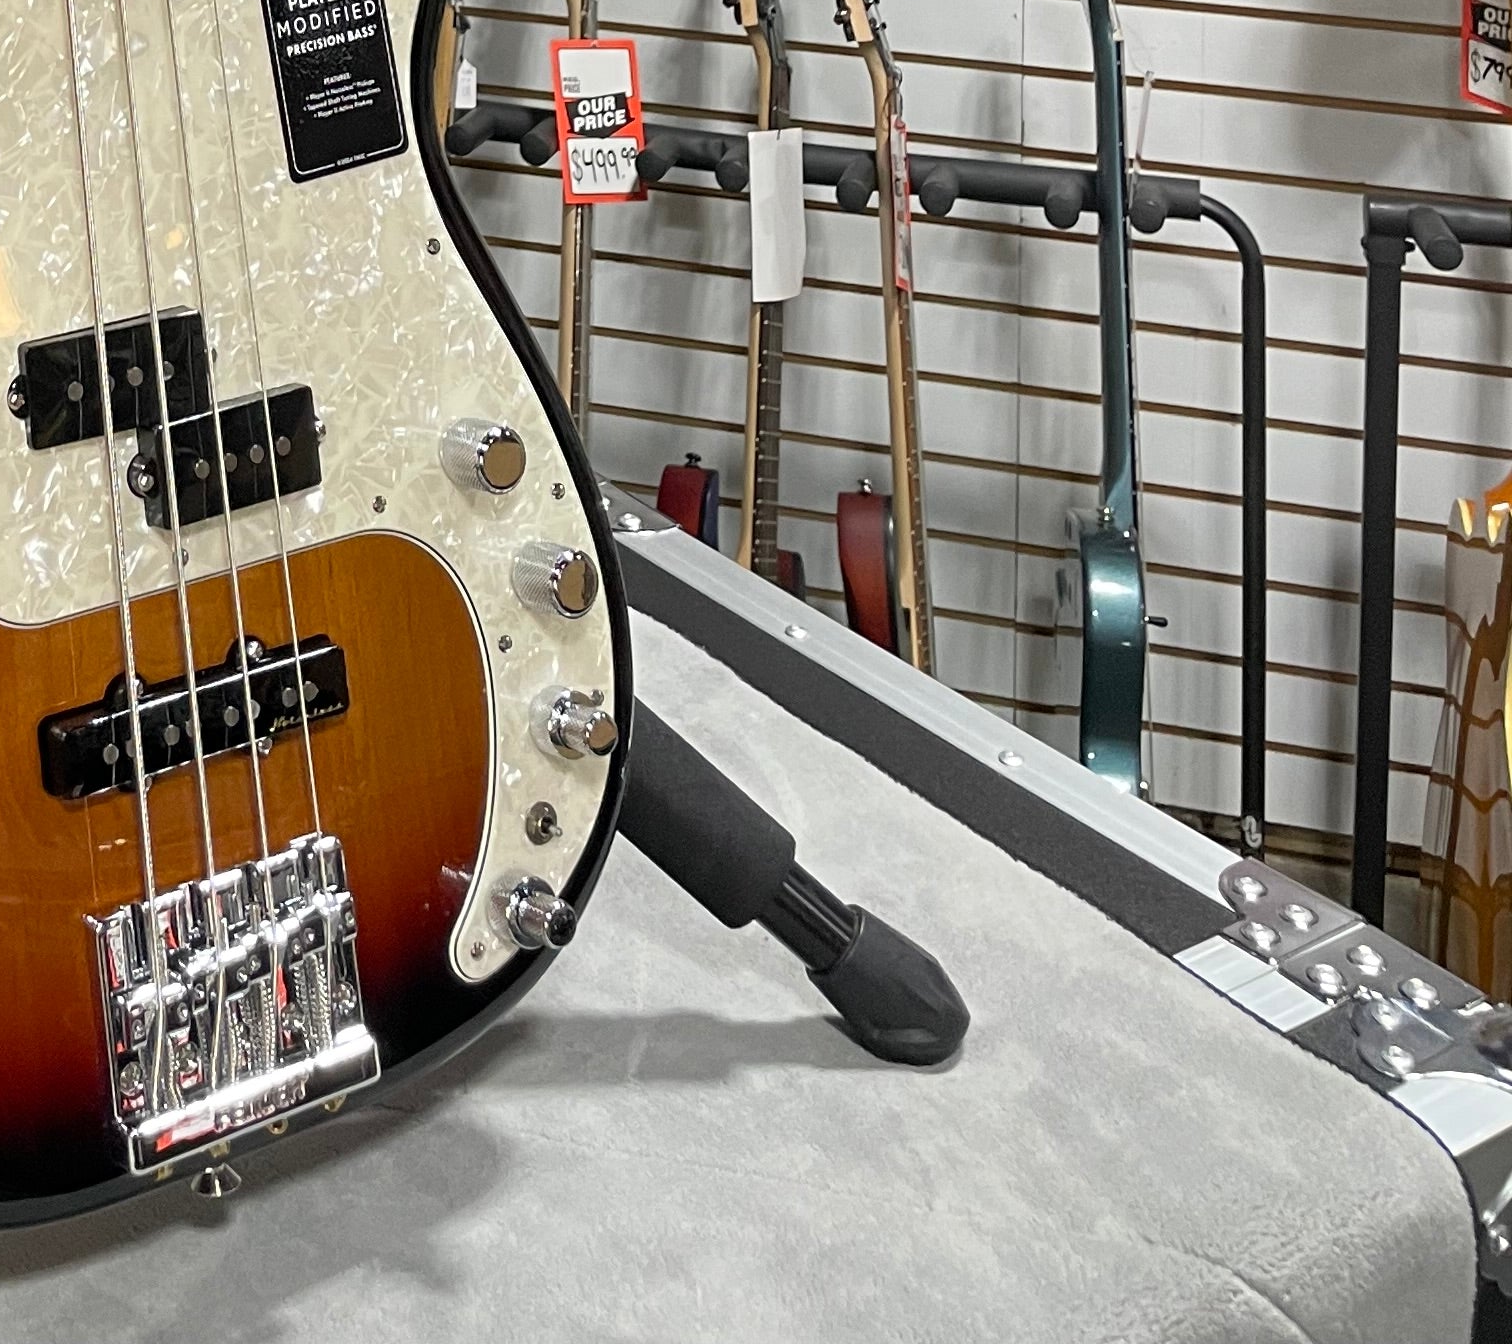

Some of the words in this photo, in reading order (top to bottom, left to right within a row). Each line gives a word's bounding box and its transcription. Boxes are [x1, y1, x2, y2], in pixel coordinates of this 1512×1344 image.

[276, 0, 376, 39] MODIFIED
[1483, 6, 1510, 25] OU
[286, 32, 346, 59] PRECISION
[577, 95, 616, 116] OUR
[573, 109, 627, 134] PRICE
